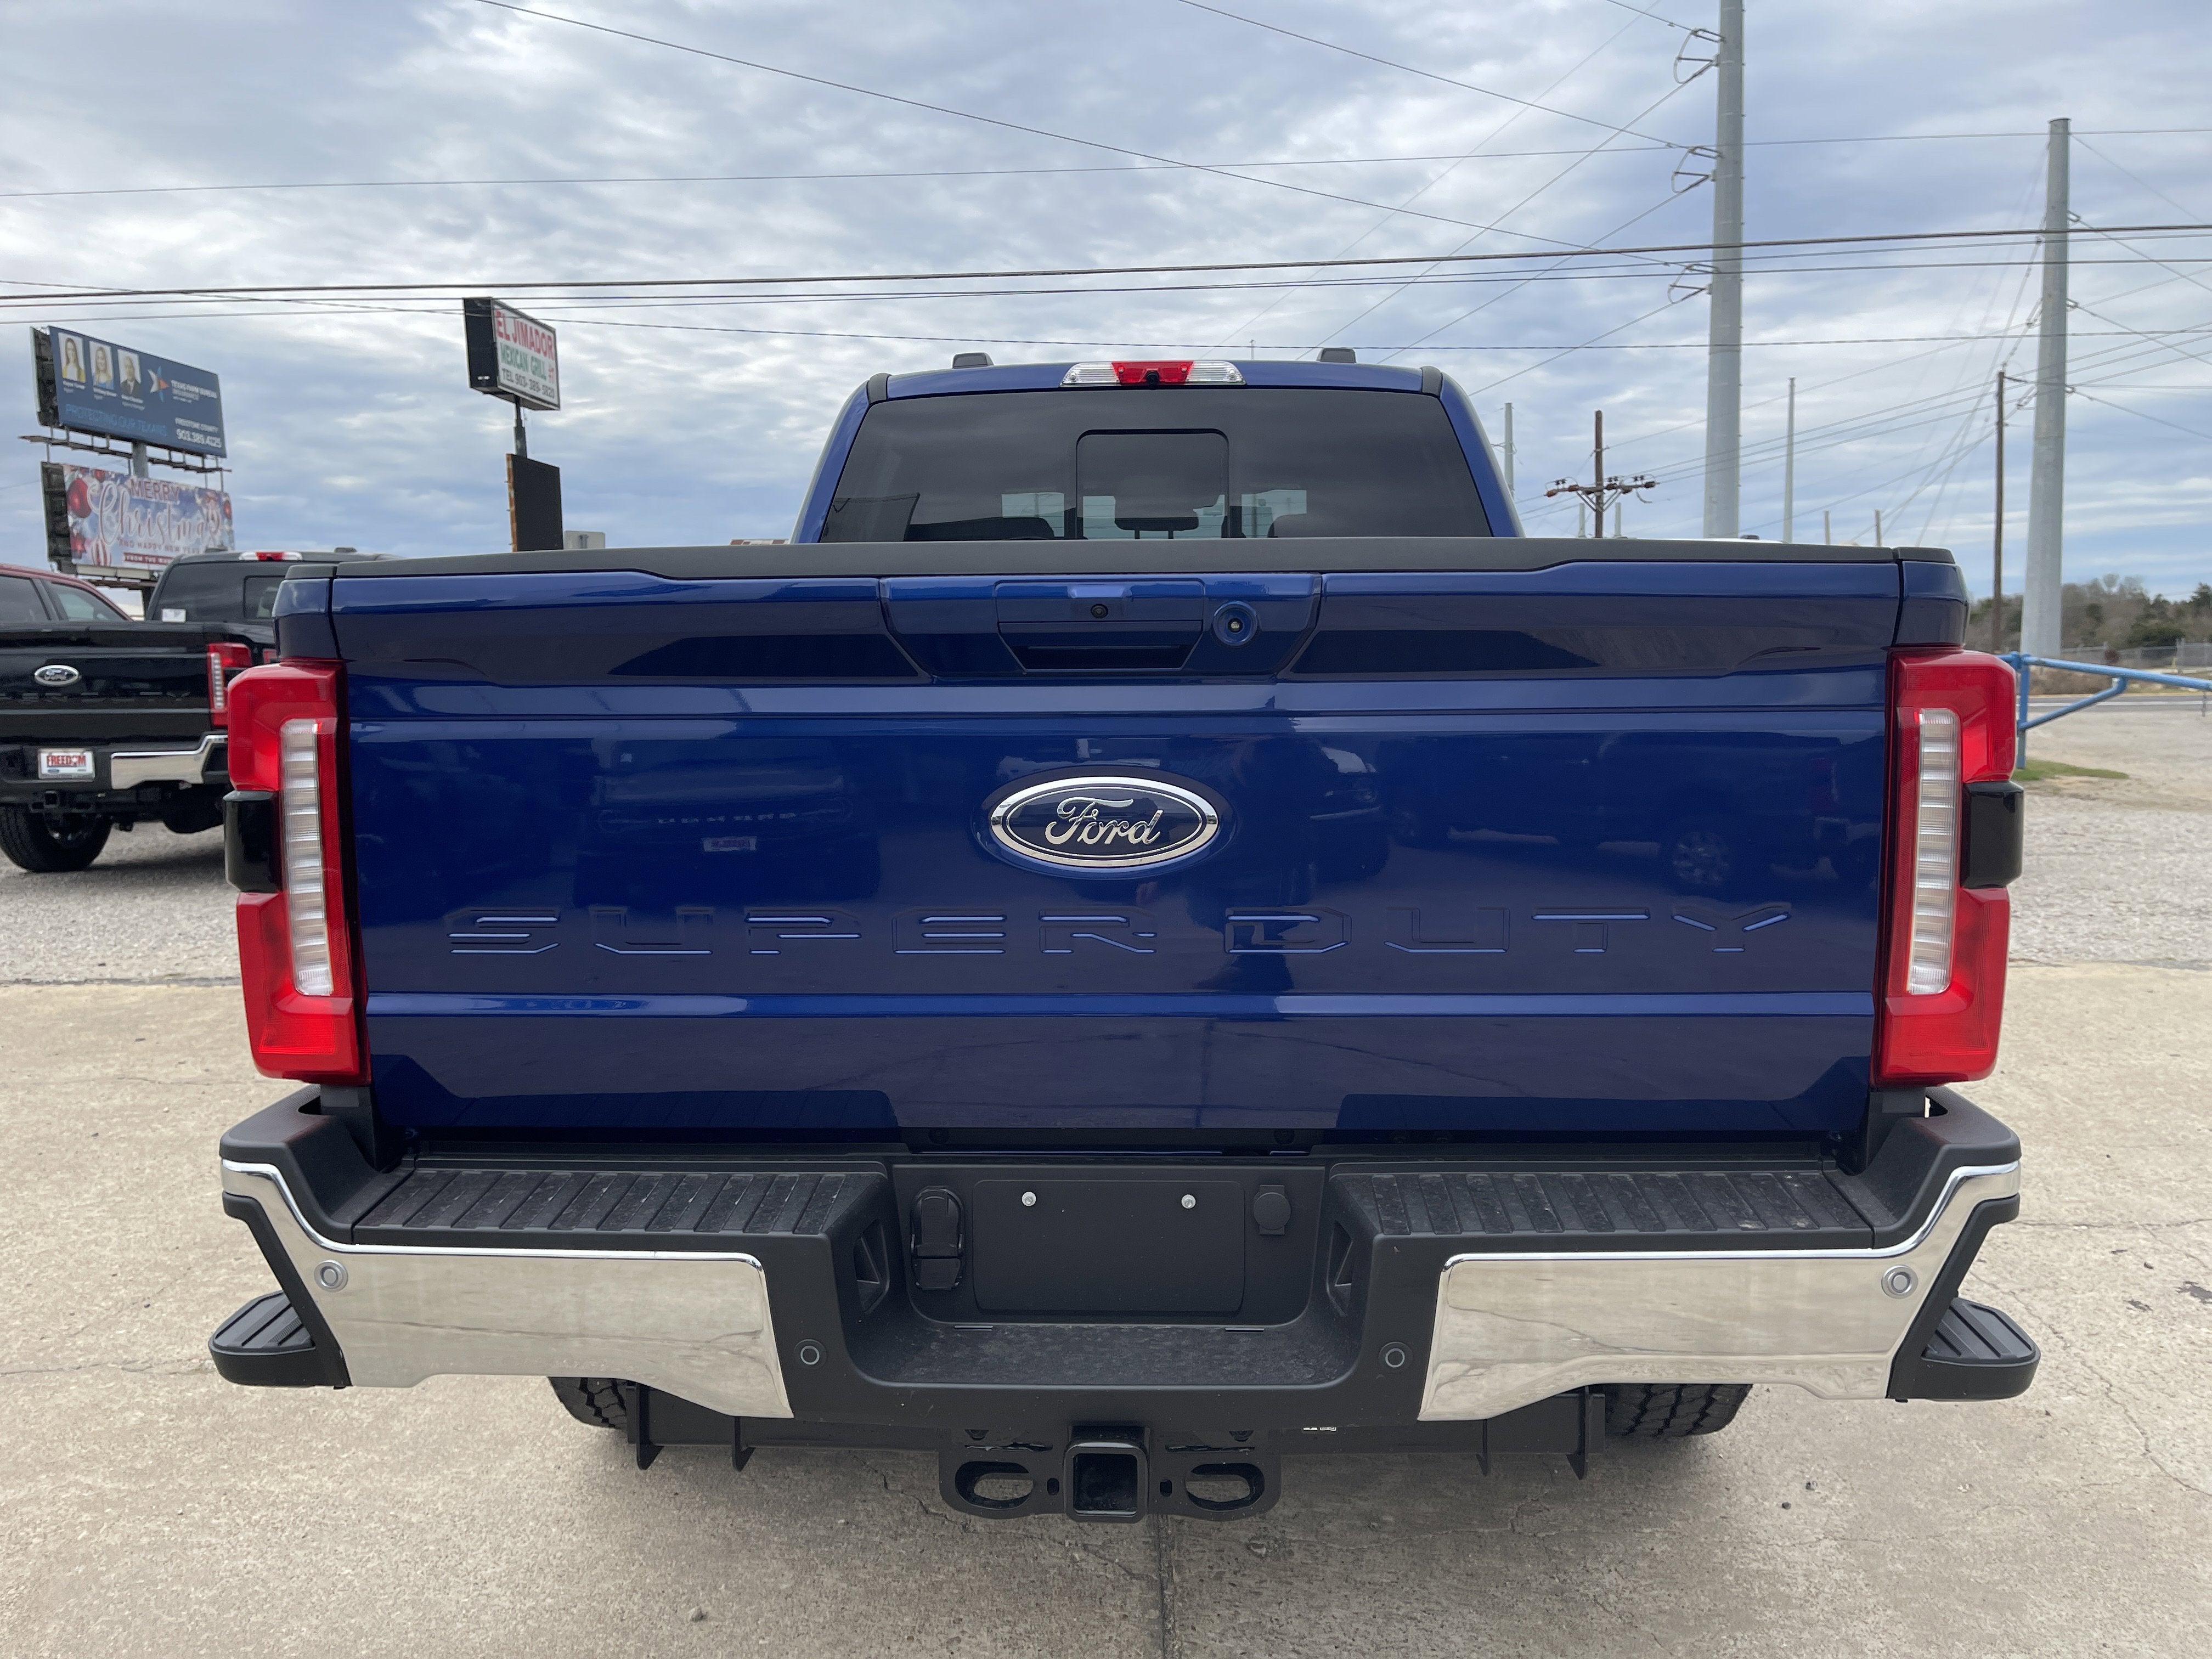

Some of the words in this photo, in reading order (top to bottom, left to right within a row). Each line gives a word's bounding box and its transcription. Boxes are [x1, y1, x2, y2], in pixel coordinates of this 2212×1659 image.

[495, 310, 510, 341] EL
[512, 319, 554, 360] JIMADOR
[500, 342, 528, 373] MEXICAN
[530, 356, 547, 381] GRILL
[87, 479, 222, 545] Christmas
[131, 478, 180, 501] MERRY
[119, 538, 134, 548] AND
[138, 542, 161, 551] HAPPY
[165, 545, 182, 553] NEW
[1045, 796, 1164, 845] Ford
[447, 906, 1159, 955] SUPER
[1223, 901, 1792, 955] DUTY
